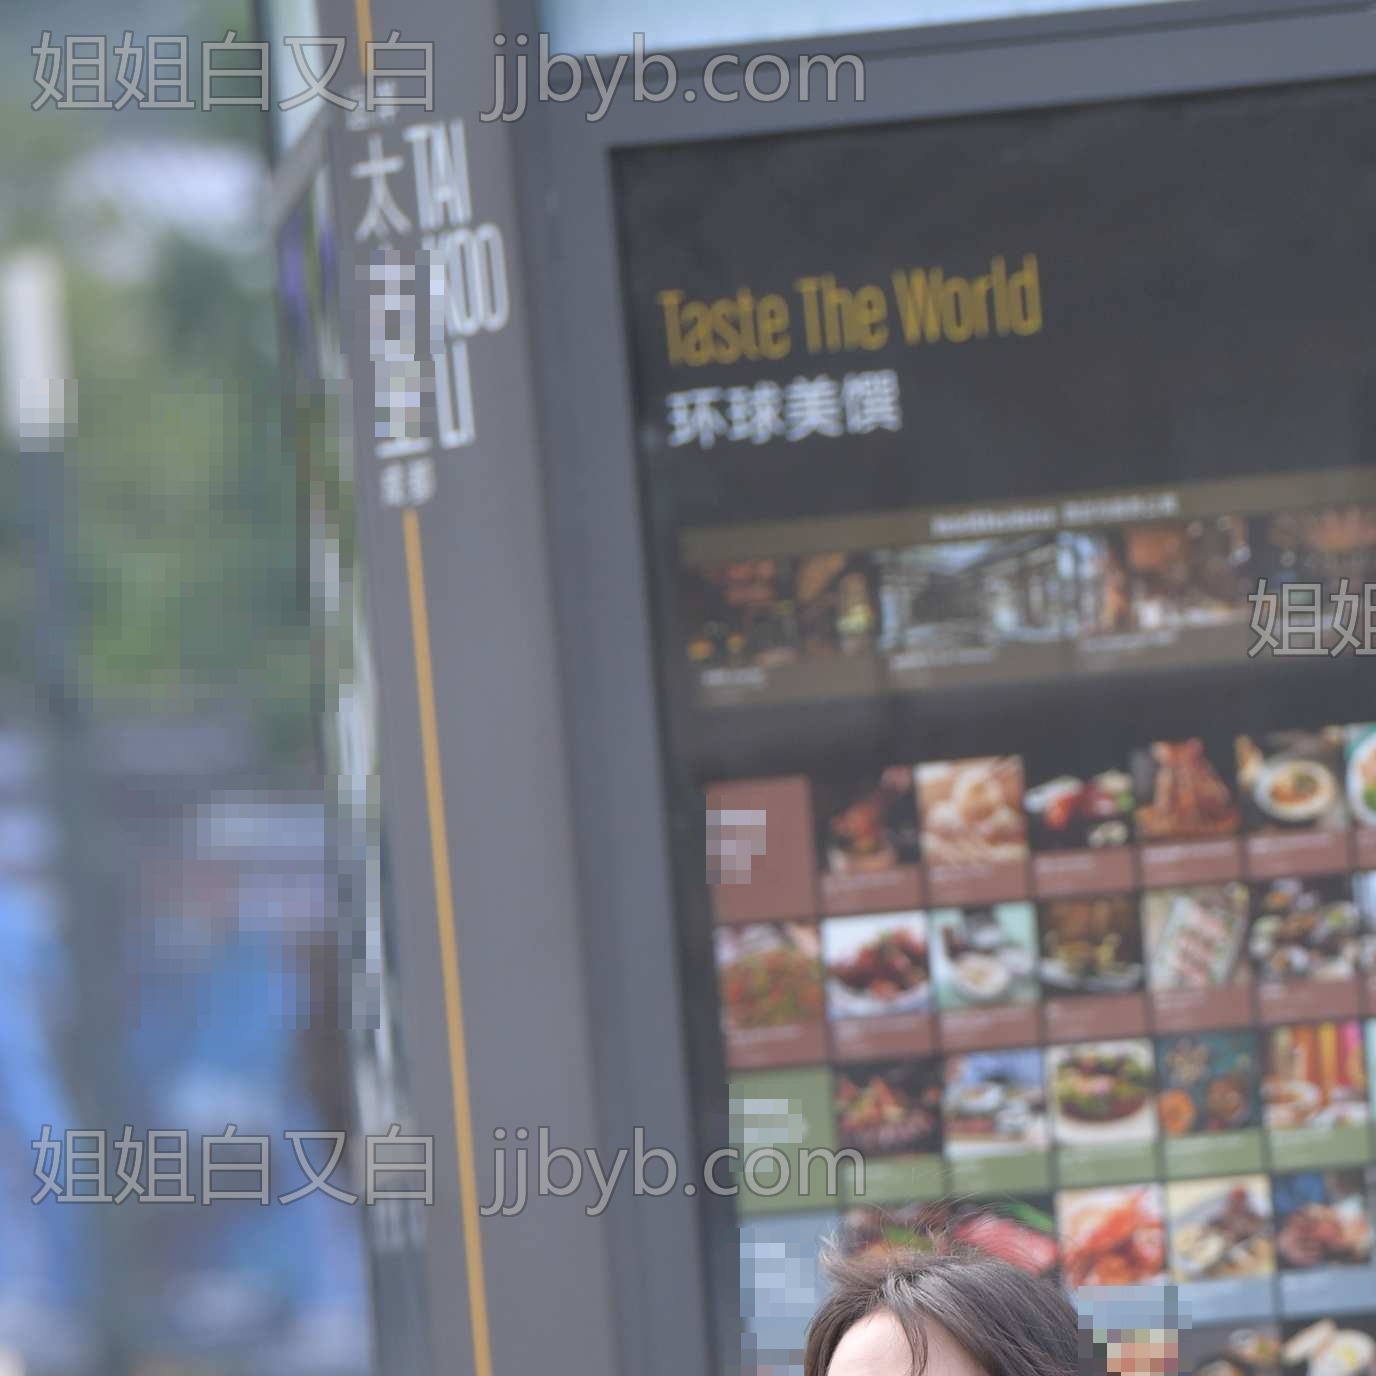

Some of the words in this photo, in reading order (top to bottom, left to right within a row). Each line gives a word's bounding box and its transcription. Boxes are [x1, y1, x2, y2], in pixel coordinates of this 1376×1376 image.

[657, 284, 792, 367] Taste
[794, 272, 889, 354] The
[891, 253, 1043, 346] World
